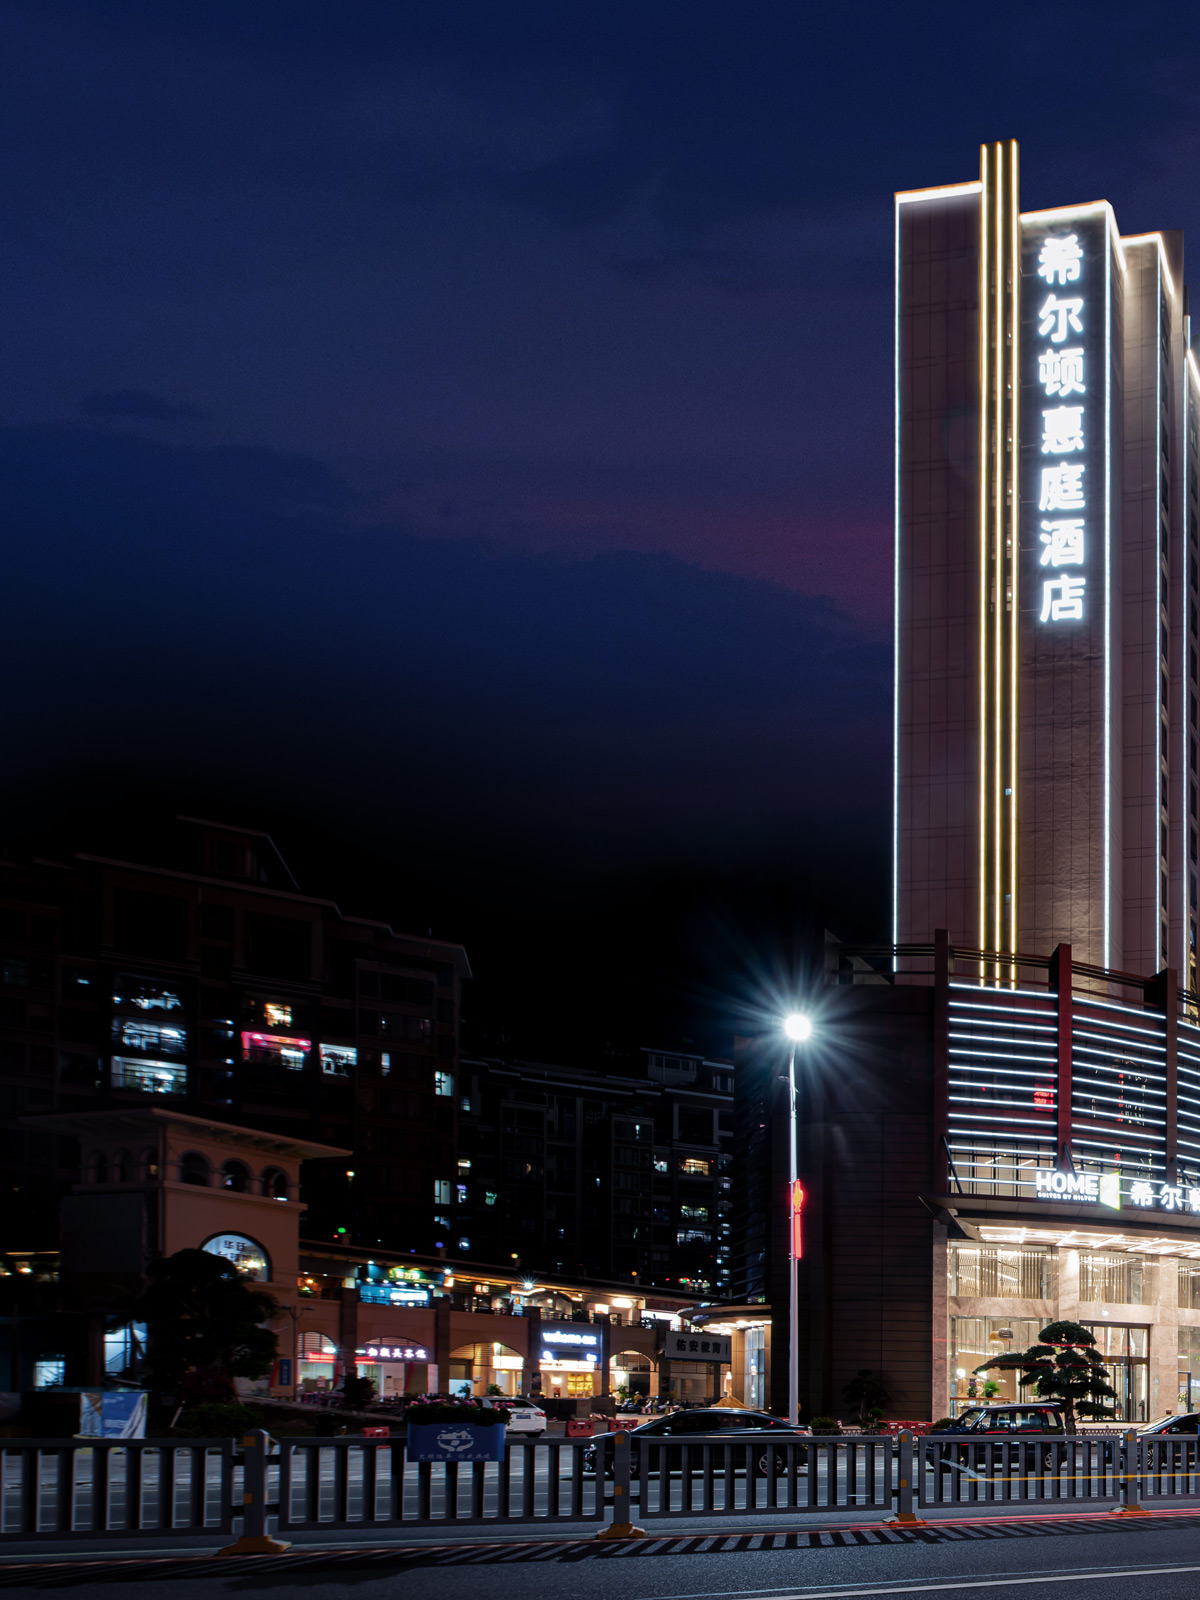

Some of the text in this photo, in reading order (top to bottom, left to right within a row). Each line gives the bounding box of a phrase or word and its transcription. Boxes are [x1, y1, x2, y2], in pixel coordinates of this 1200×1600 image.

[1038, 234, 1086, 623] 希尔顿惠庭酒店
[1036, 1172, 1099, 1196] HOME
[676, 1339, 721, 1354] 佑安教育
